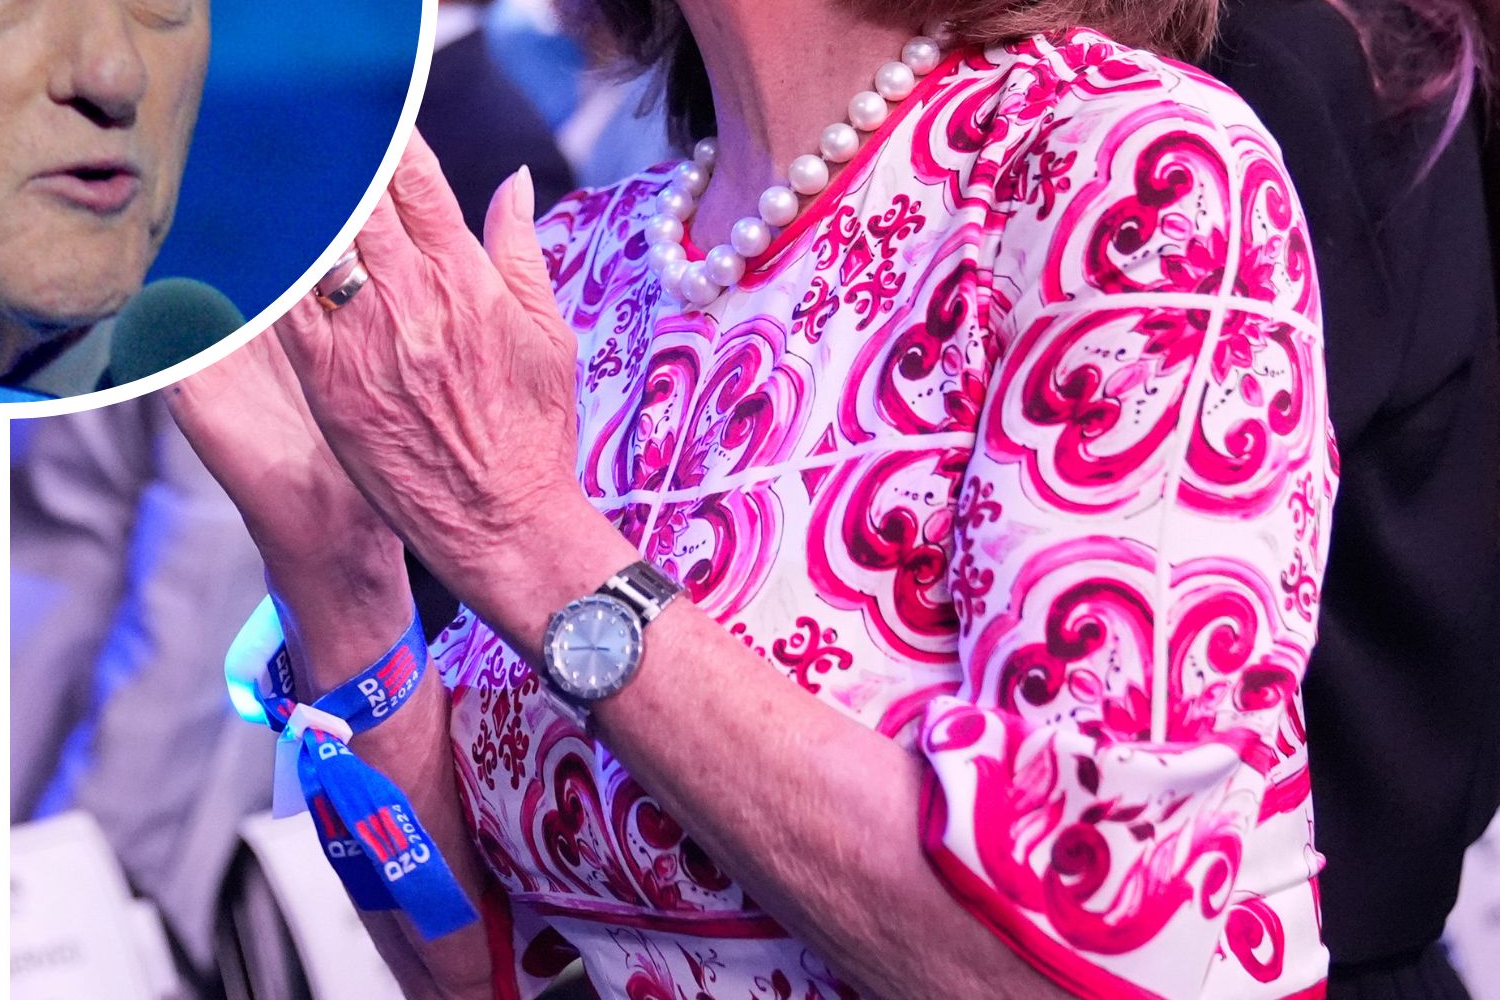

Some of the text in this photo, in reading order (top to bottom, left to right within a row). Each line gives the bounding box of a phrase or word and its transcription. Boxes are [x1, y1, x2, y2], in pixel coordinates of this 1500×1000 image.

[357, 678, 389, 718] DNC
[390, 670, 419, 707] 2024
[392, 804, 422, 842] 2024
[384, 843, 431, 882] DNC
